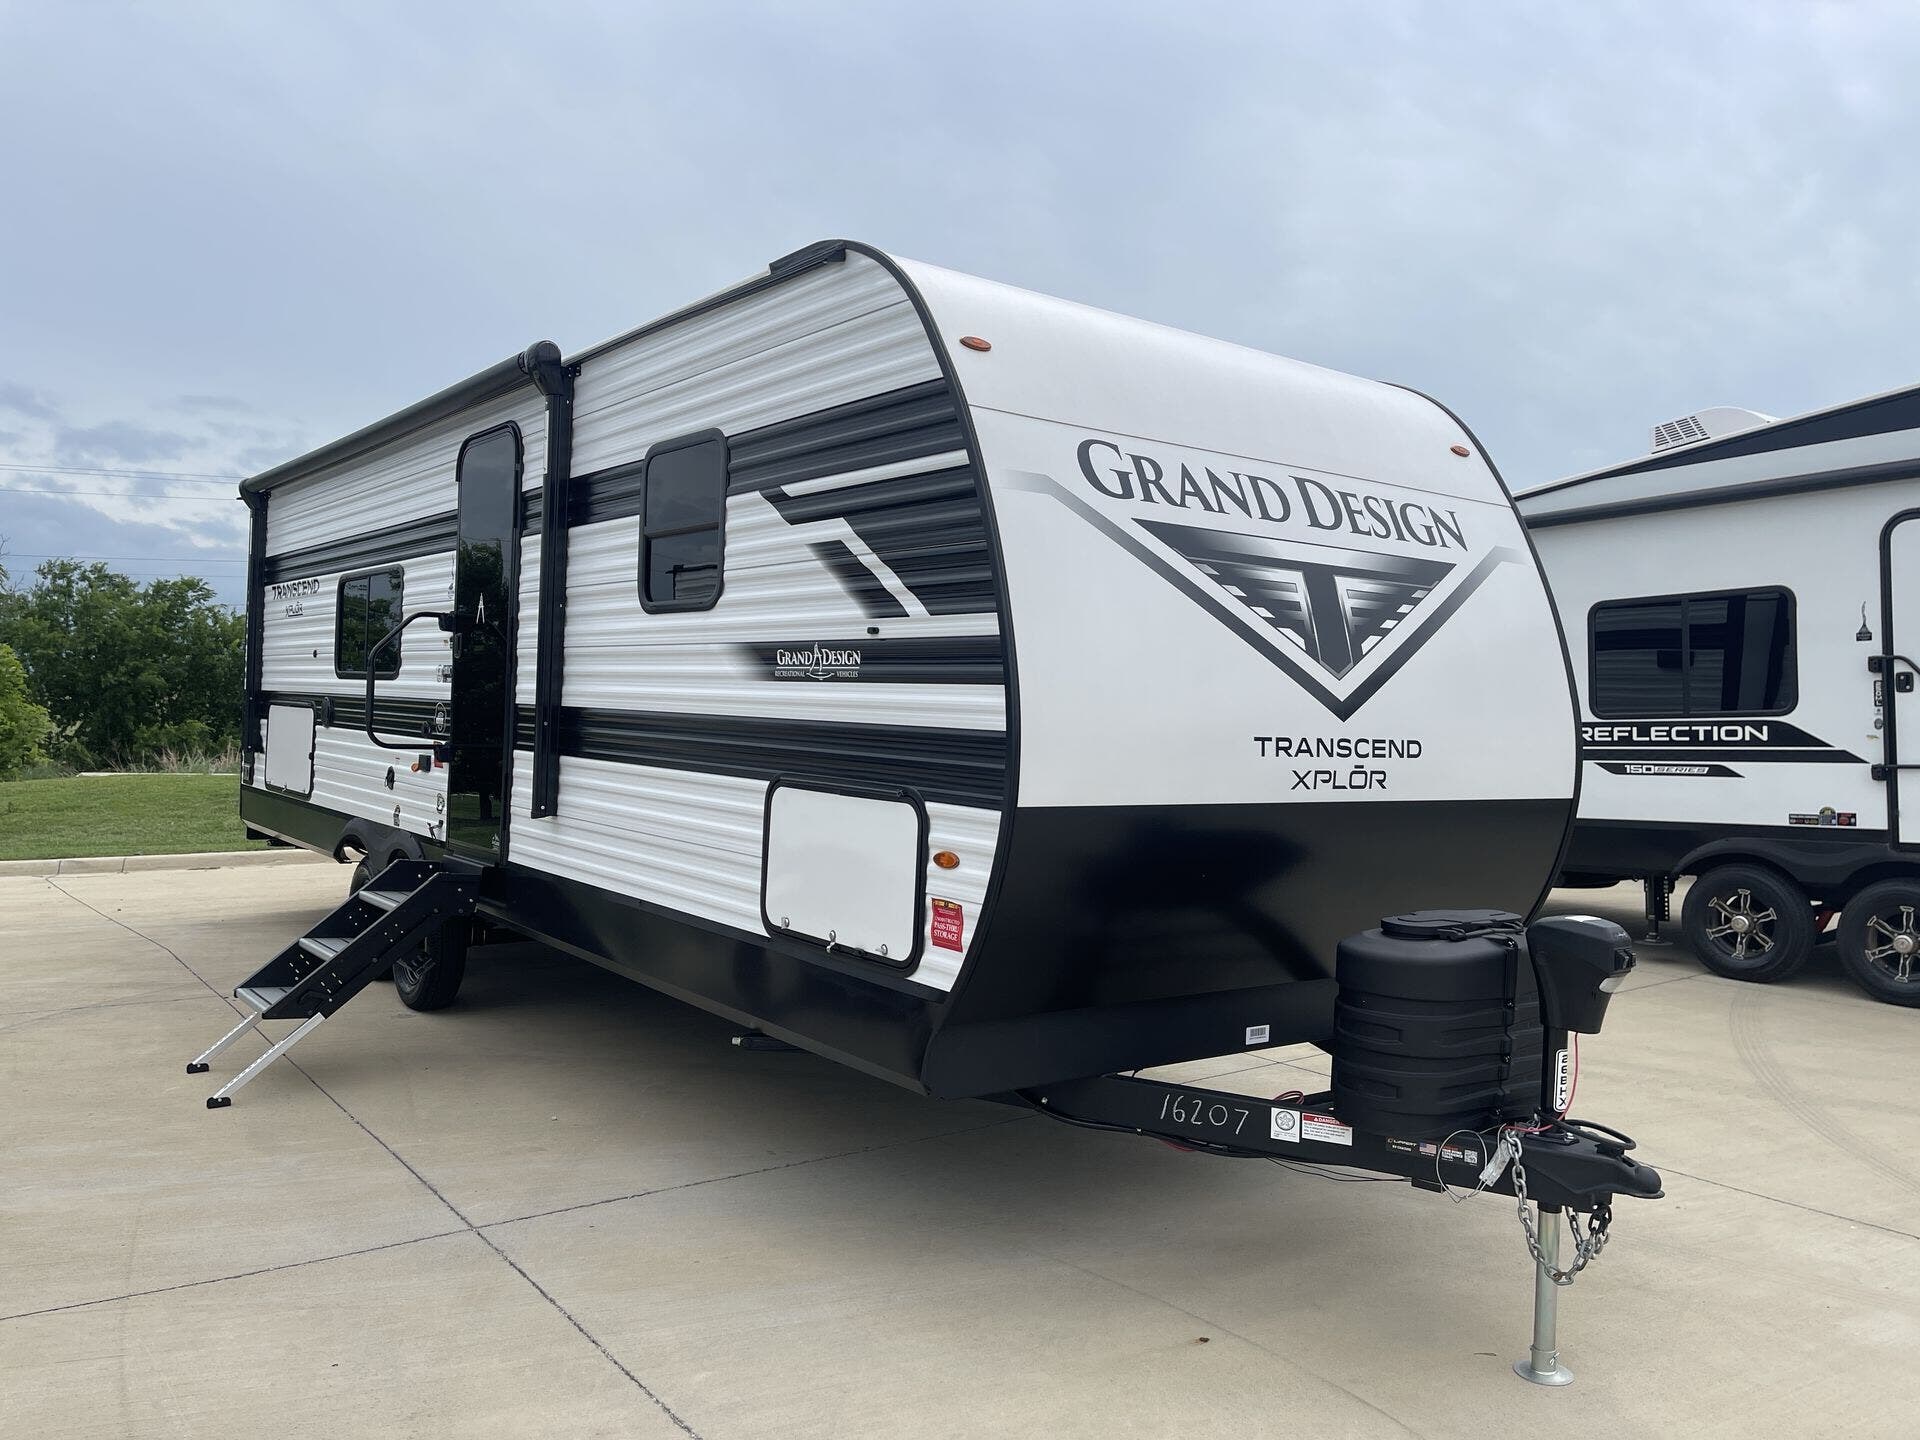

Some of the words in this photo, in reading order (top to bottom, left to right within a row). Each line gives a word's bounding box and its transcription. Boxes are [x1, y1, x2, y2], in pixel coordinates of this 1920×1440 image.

[1076, 438, 1291, 523] GRAND
[1288, 474, 1469, 552] DESIGN
[271, 579, 320, 600] TRANSCEND
[776, 649, 813, 665] GRAND
[820, 648, 861, 665] DESIGN
[774, 669, 806, 678] RECREATIONAL
[836, 670, 859, 678] VEHICLES
[1581, 725, 1769, 742] REFLECTION
[1253, 736, 1423, 759] TRANSCEND
[933, 929, 959, 942] STORAGE
[1160, 1093, 1249, 1135] 16207
[1318, 1117, 1341, 1125] DANGER
